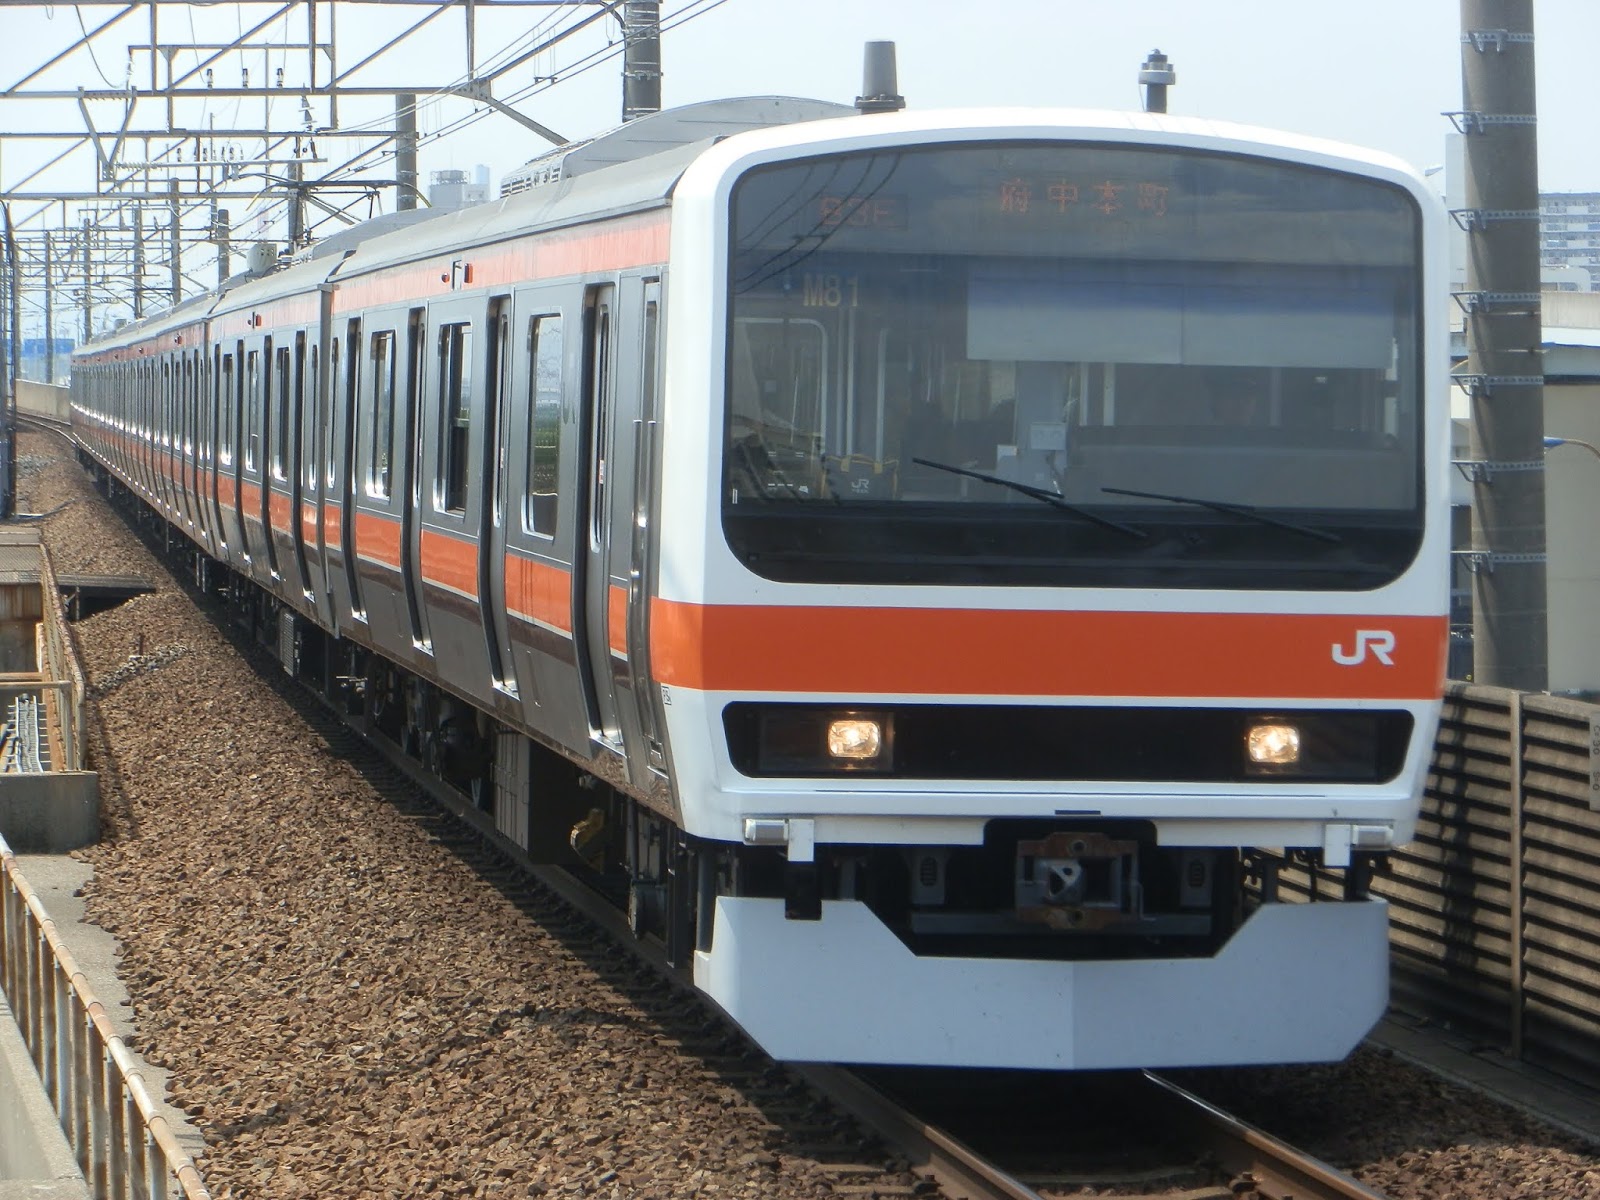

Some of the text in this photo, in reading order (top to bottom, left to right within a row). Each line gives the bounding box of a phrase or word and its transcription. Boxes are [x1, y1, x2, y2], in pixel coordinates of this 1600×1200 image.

[1000, 177, 1169, 217] 府中本町
[803, 272, 858, 307] M81
[852, 479, 869, 489] JR
[1332, 630, 1395, 665] JR
